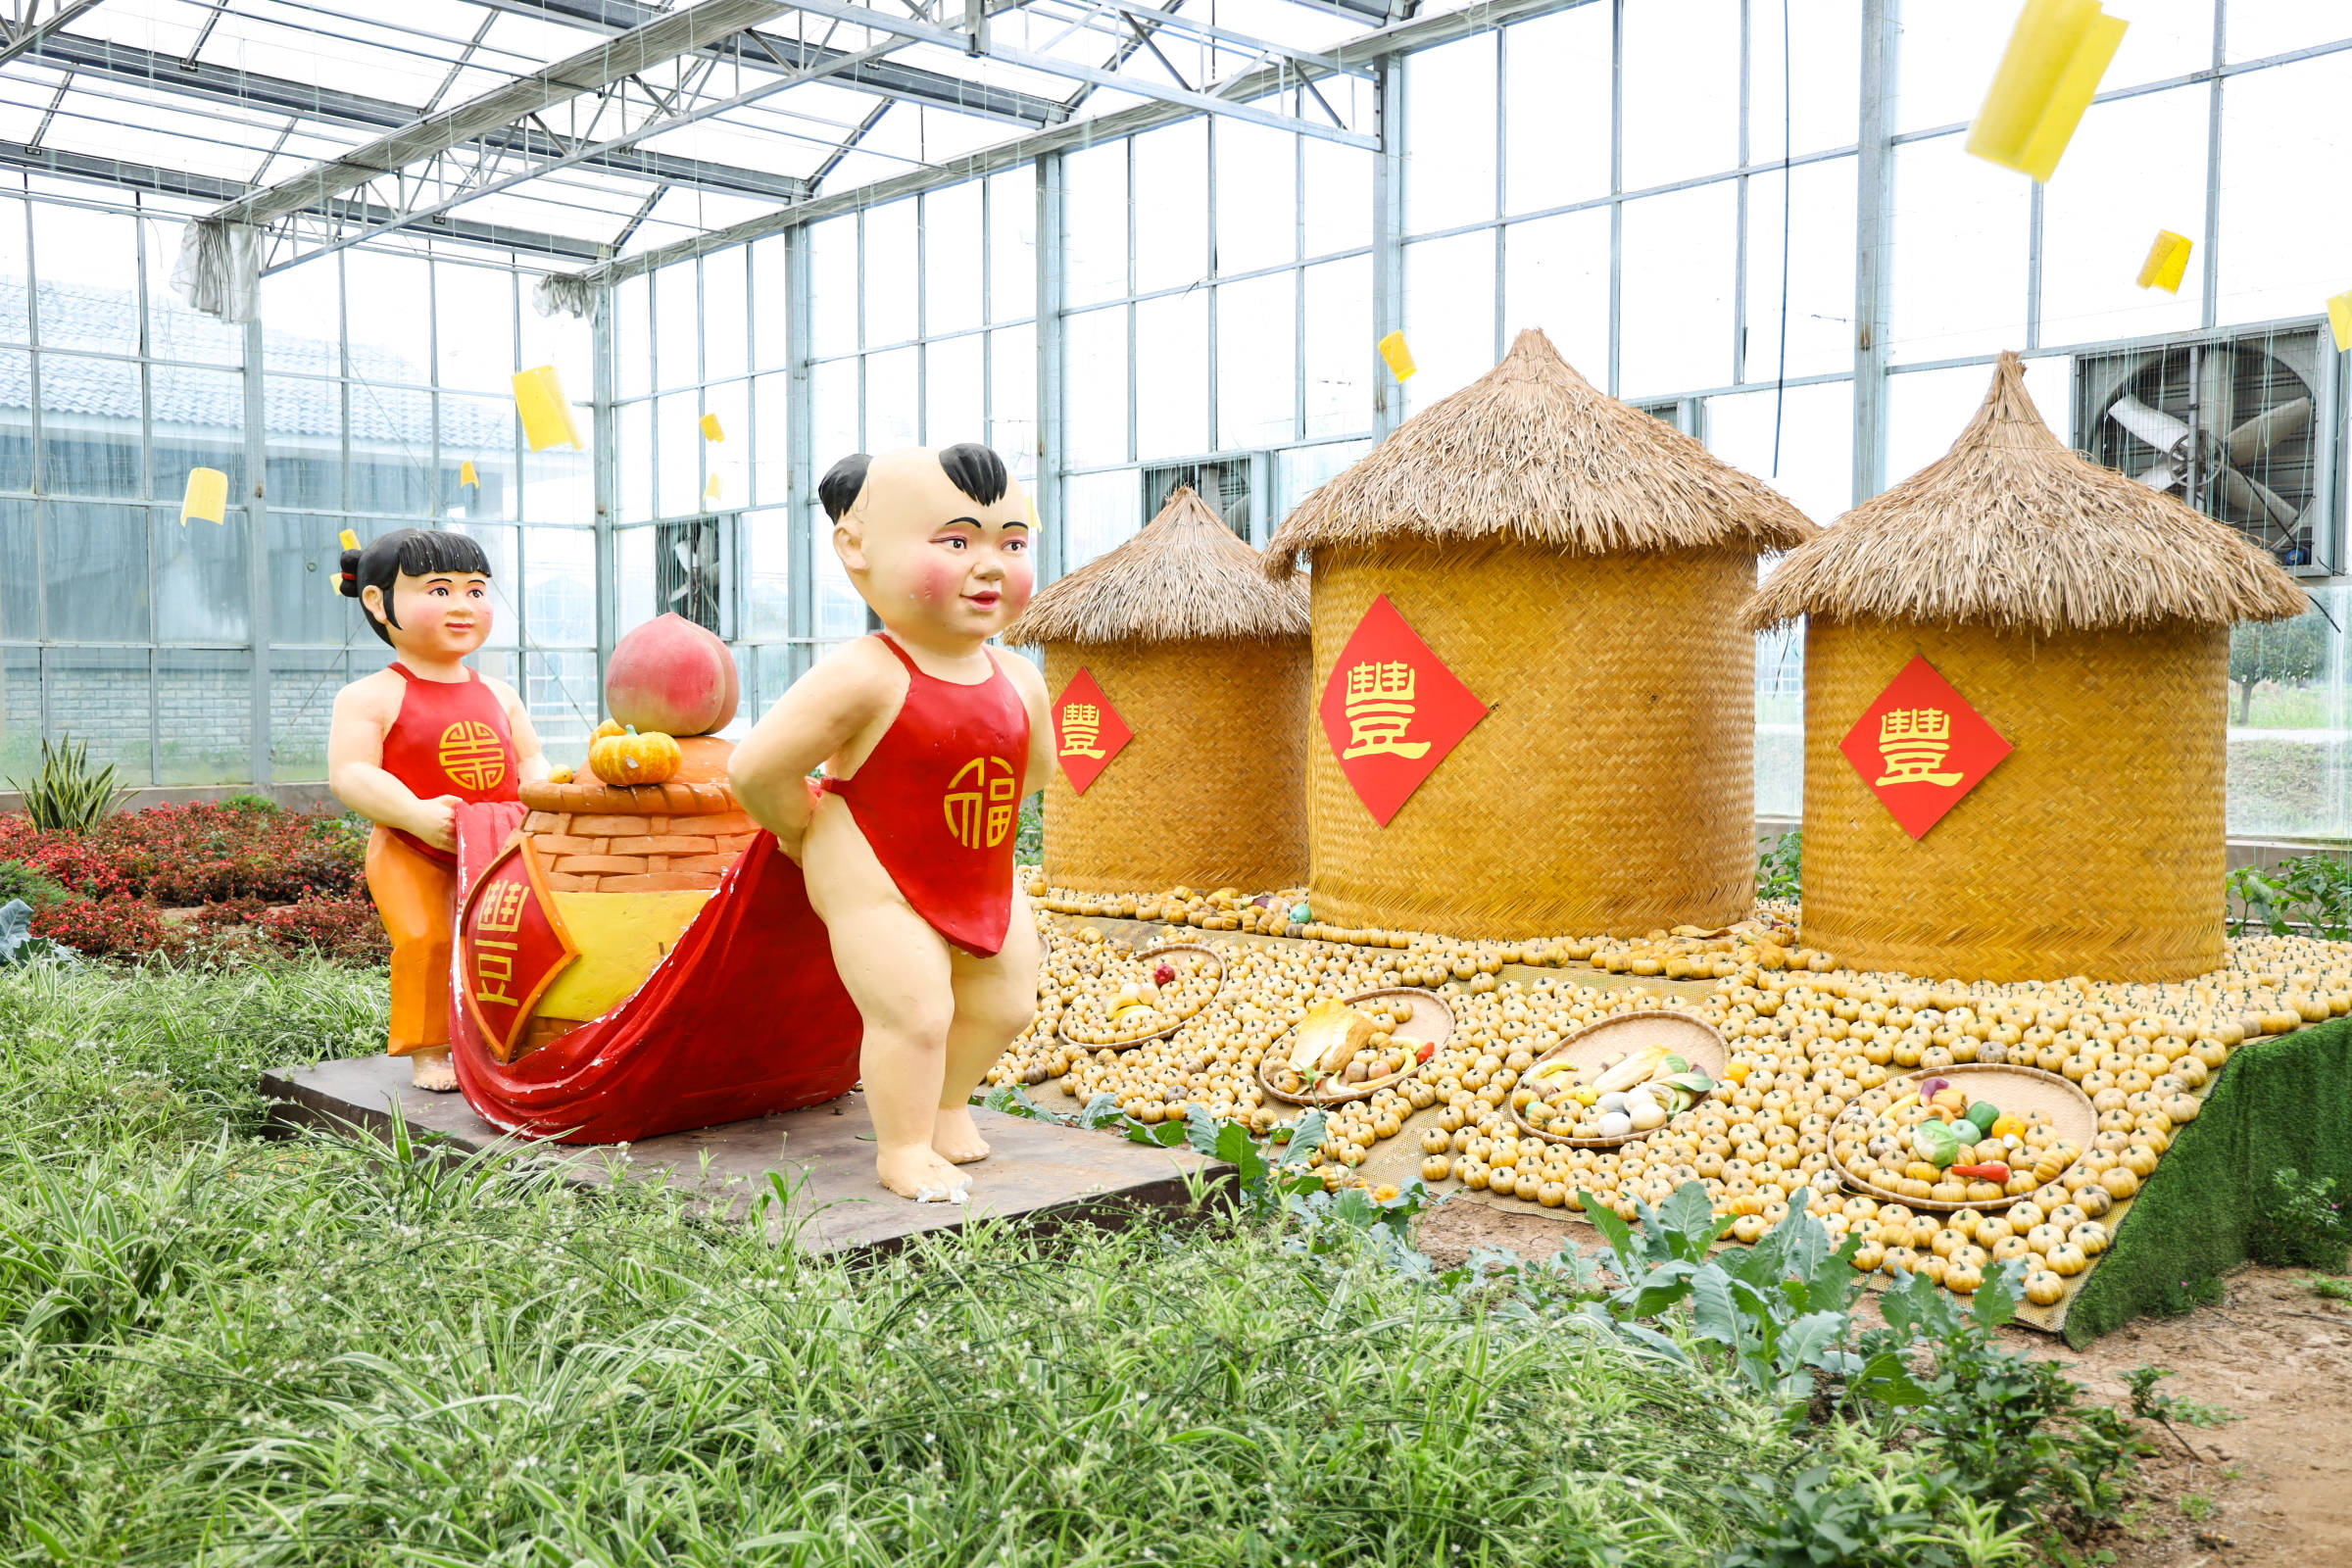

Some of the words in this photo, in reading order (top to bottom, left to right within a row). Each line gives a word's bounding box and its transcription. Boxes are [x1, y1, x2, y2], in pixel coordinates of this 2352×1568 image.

[1059, 702, 1107, 760] 豐
[1342, 659, 1433, 761] 豐
[1874, 707, 1965, 788] 豐
[943, 755, 1016, 850] 福
